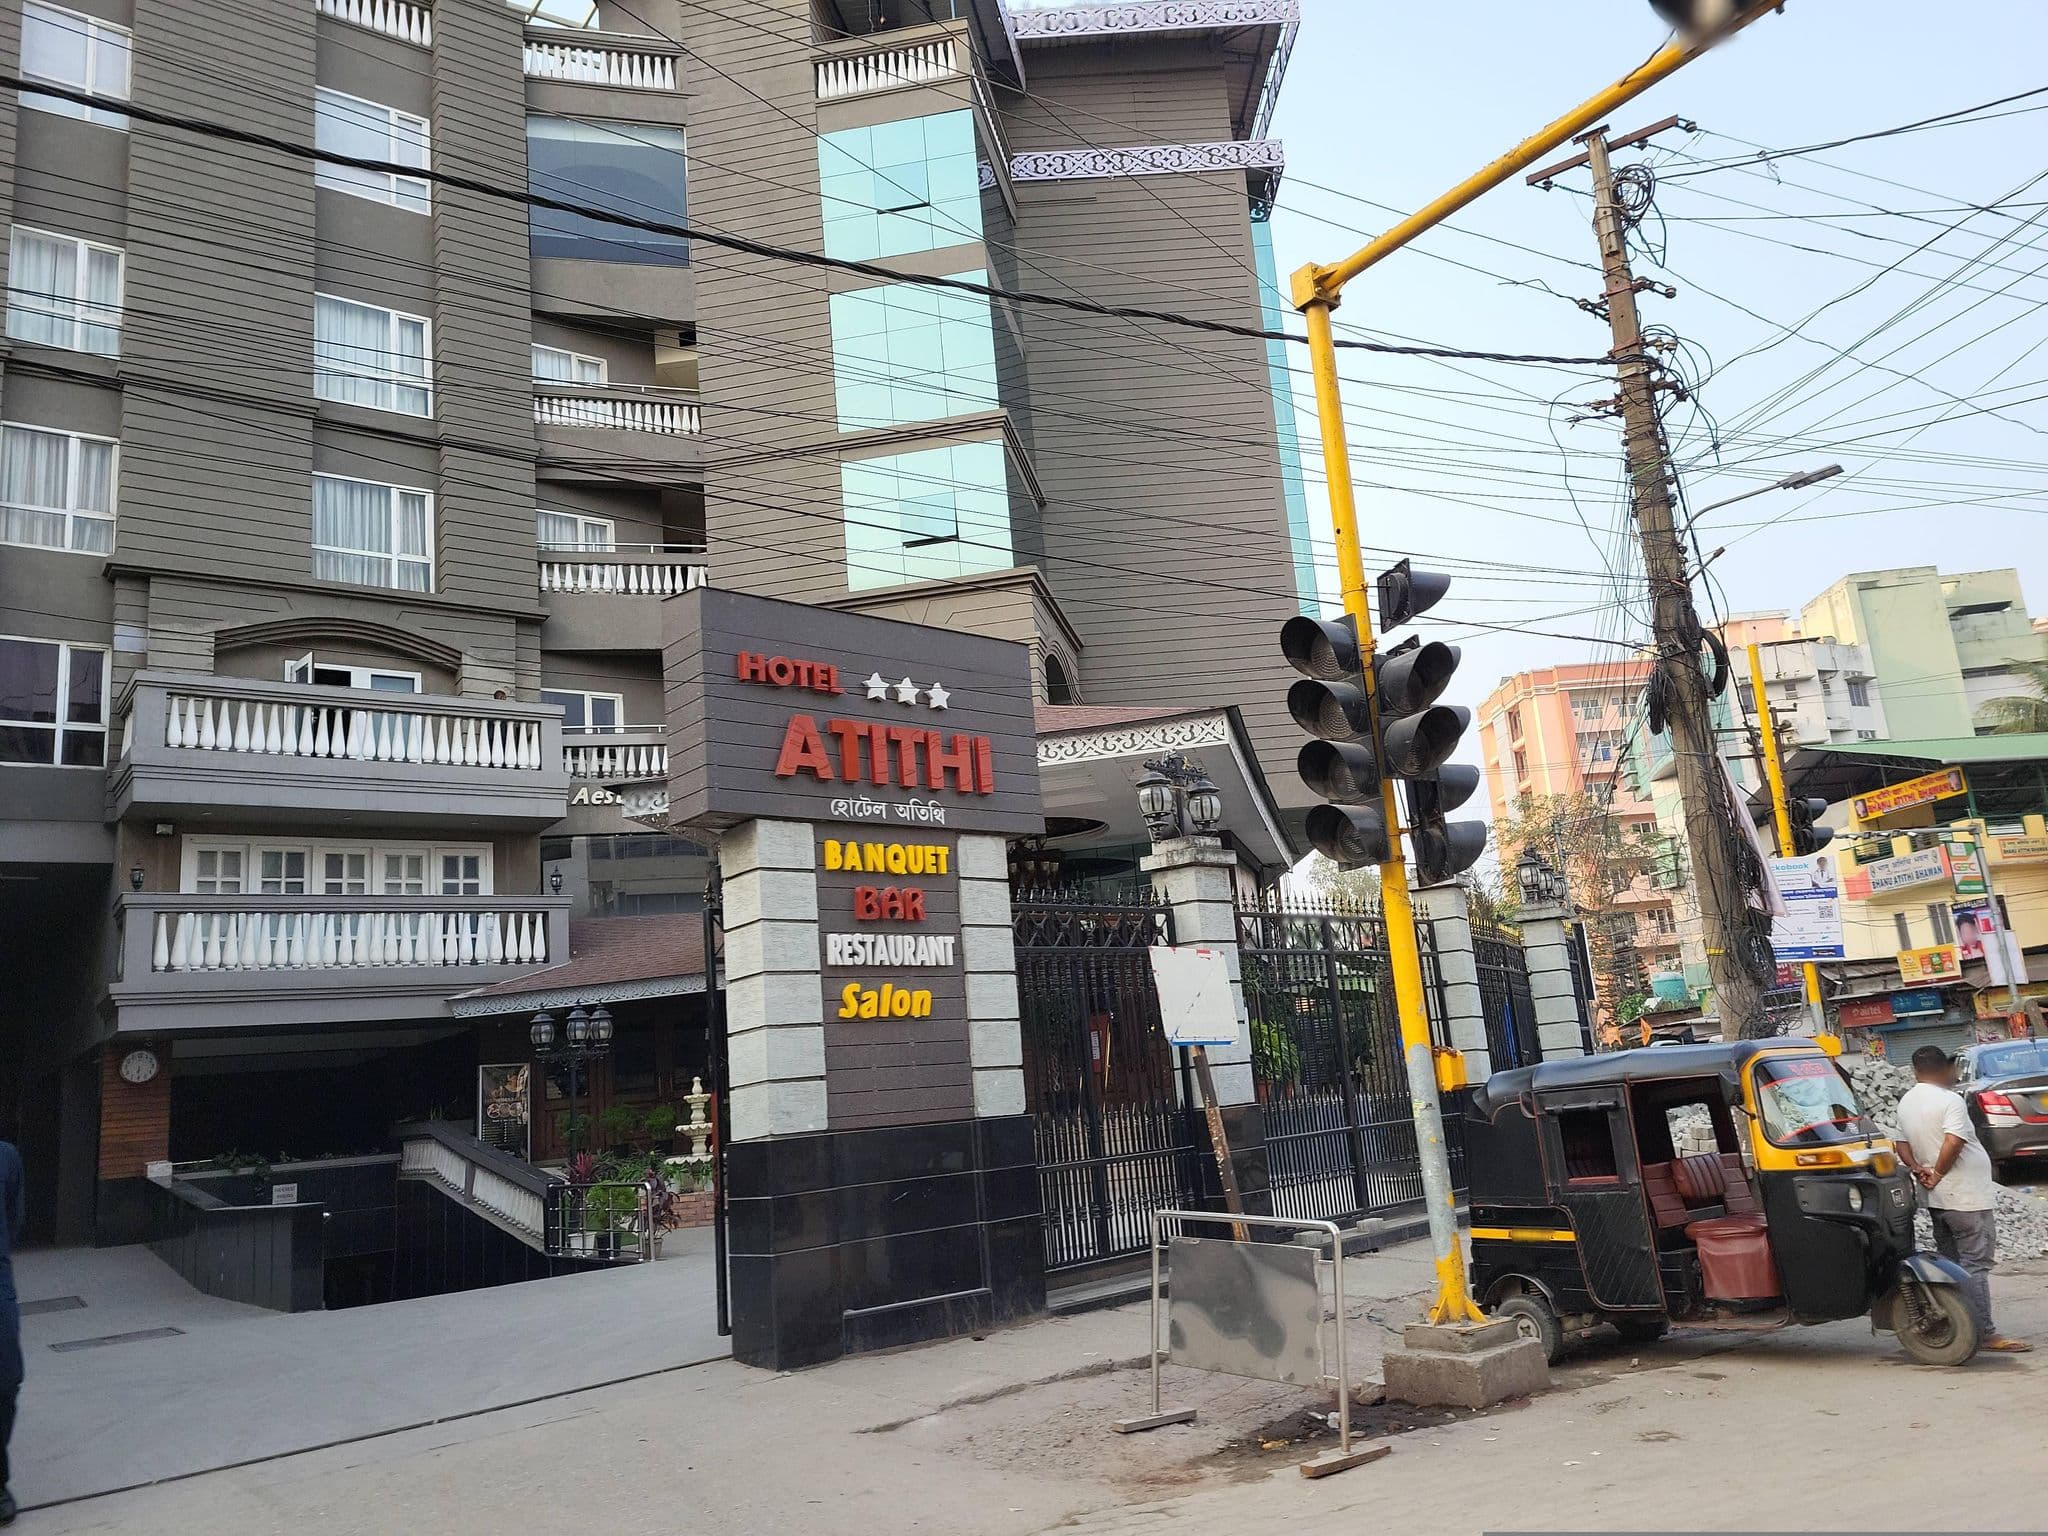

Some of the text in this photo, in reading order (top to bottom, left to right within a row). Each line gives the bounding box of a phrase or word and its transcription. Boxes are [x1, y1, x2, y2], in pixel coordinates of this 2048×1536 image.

[737, 651, 845, 695] HOTEL
[774, 714, 994, 795] ATITHI
[830, 794, 946, 825] হোটেল অতিথি
[824, 839, 950, 875] BANQUET
[854, 886, 926, 921] BAR
[826, 933, 955, 968] RESTAURANT
[838, 983, 933, 1019] Salon
